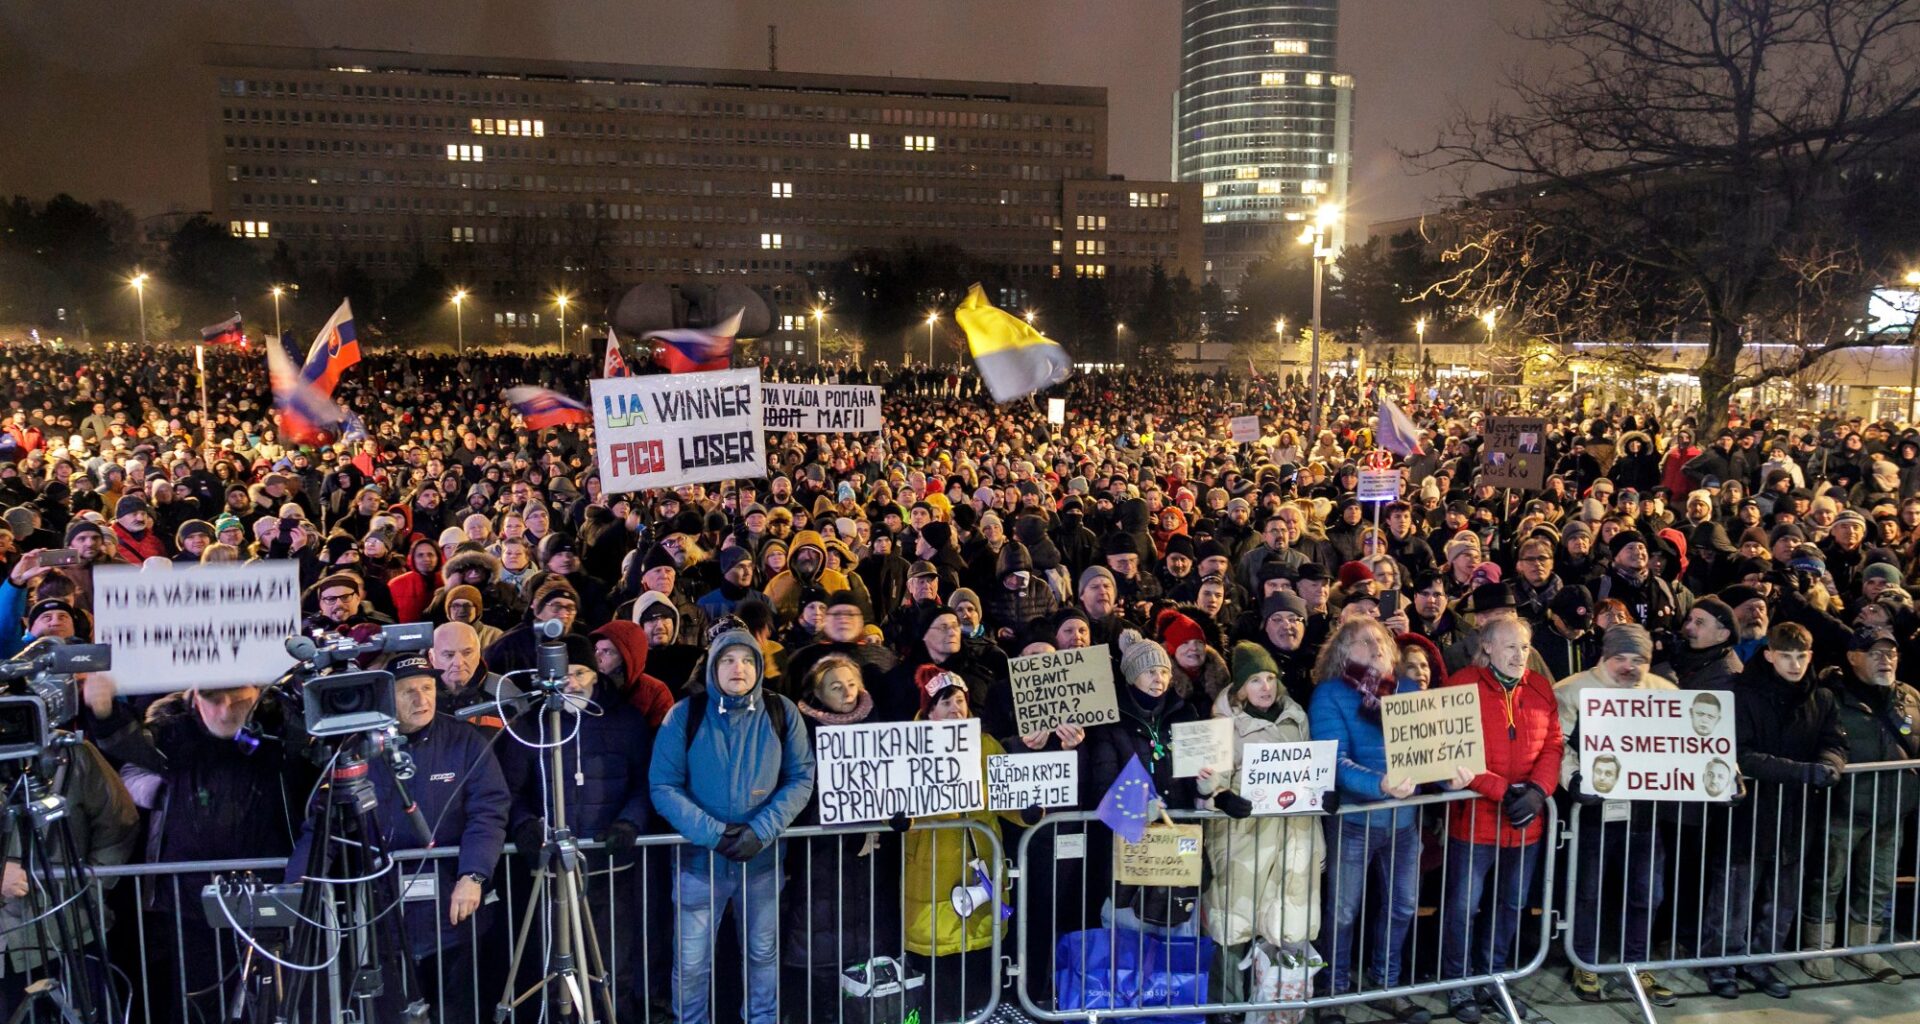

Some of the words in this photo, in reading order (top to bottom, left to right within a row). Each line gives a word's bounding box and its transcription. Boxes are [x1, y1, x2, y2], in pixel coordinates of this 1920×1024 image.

[604, 393, 648, 428] UA
[651, 384, 751, 423] WINNER
[783, 387, 819, 407] VLÁDA
[825, 387, 876, 408] POMÁHA
[817, 409, 864, 428] MAFII
[610, 439, 666, 477] FICO
[678, 431, 754, 470] LOSER
[1011, 658, 1040, 674] KDE
[1042, 655, 1062, 669] SA
[1064, 650, 1084, 666] DA
[1014, 668, 1069, 689] VYBAVIŤ
[1385, 697, 1437, 716] PODLIAK
[1441, 692, 1475, 708] FICO
[1587, 694, 1682, 718] PATRÍTE
[1066, 710, 1104, 725] 4000
[1107, 708, 1116, 720] €
[1390, 716, 1475, 743] DEMONTUJE
[817, 727, 901, 760] POLITIKA
[906, 726, 934, 755] NIE
[942, 724, 969, 753] JE
[1584, 735, 1615, 752] NA
[1620, 735, 1731, 755] SMETISKO
[988, 755, 1009, 768] KDE
[1252, 747, 1312, 765] „BANDA
[1391, 746, 1434, 769] PRÁVNY
[1437, 739, 1476, 761] ŠTÁT
[831, 759, 894, 791] ÚKRYT
[907, 756, 961, 787] PRED
[989, 763, 1029, 783] VLÁDA
[1033, 763, 1071, 782] KRYJE
[1247, 765, 1311, 785] ŠPINAVÁ
[1627, 768, 1695, 791] DEJÍN
[988, 783, 1010, 793] TAM
[990, 790, 1029, 809] MAFIA
[1032, 785, 1070, 806] ŽIJE
[822, 778, 982, 822] SPRAVODLIVOSŤOU
